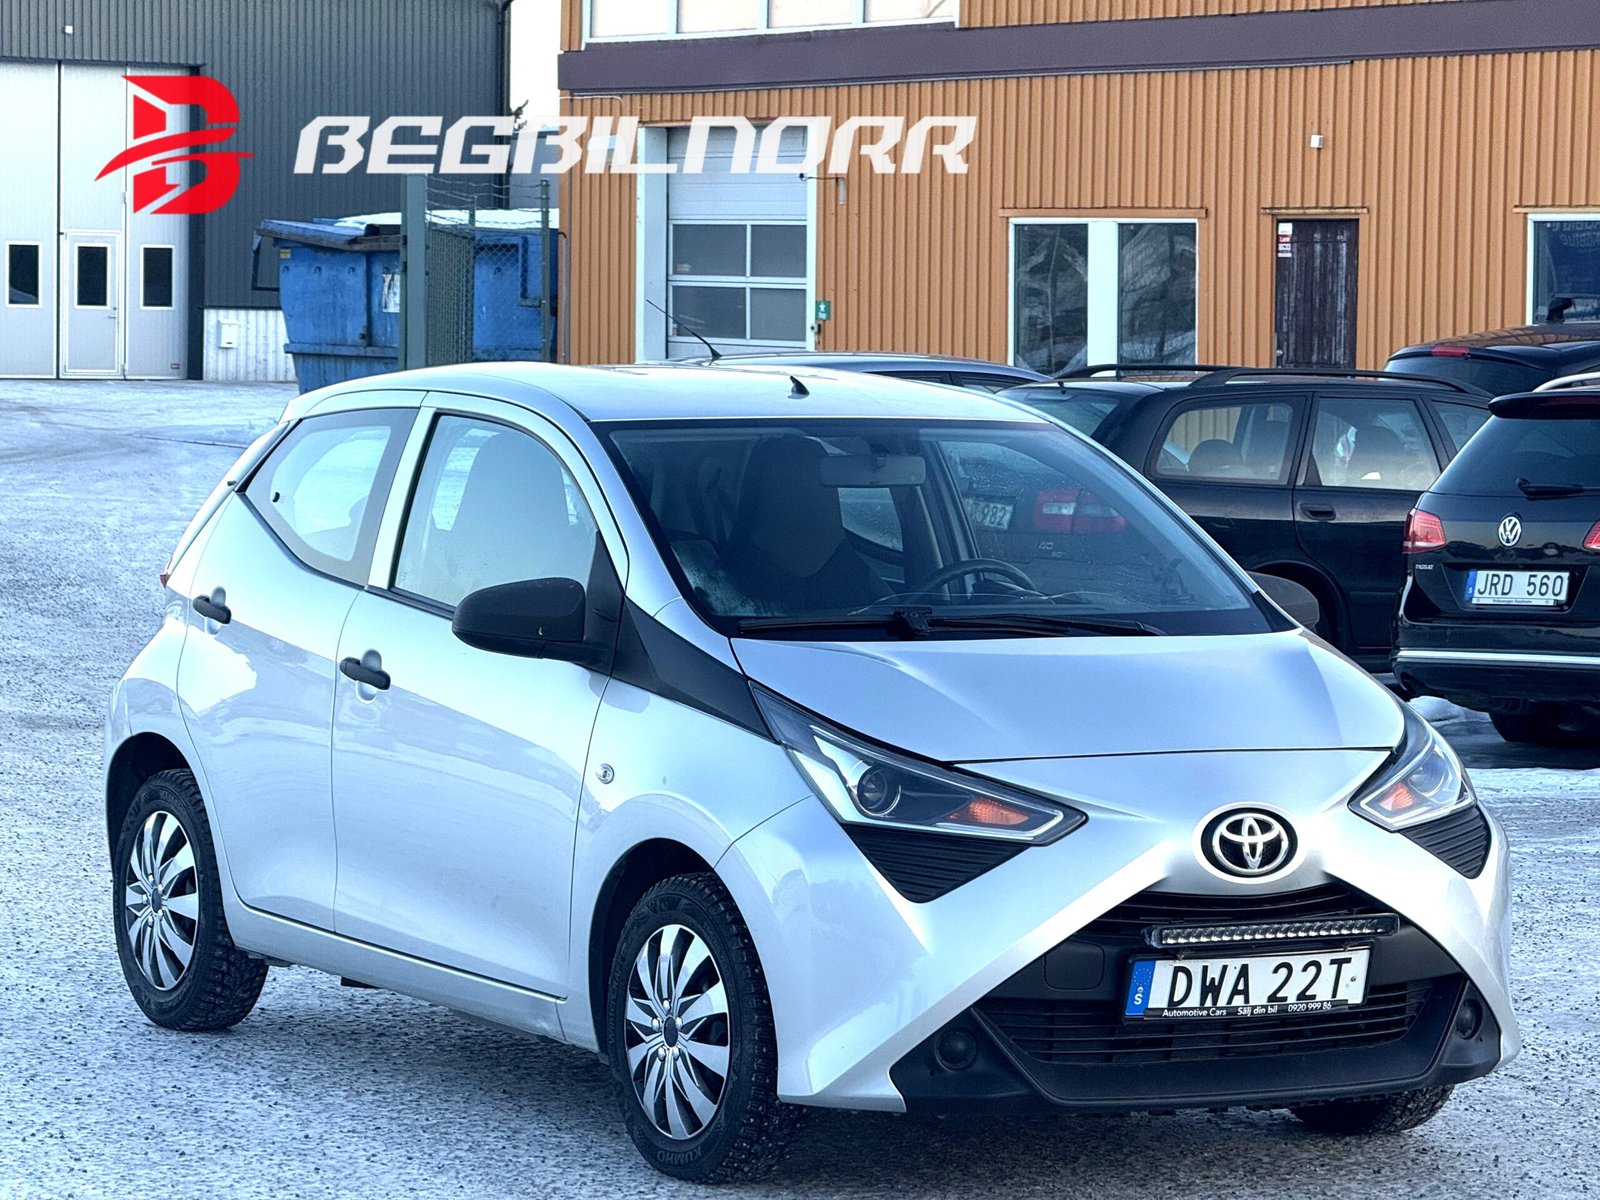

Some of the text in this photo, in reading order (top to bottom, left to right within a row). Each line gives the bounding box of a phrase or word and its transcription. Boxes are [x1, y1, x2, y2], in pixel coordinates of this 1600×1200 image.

[1477, 573, 1564, 597] JRD 560
[1167, 957, 1353, 1008] DWA 22T
[1162, 1007, 1227, 1018] Automotive Cars
[1237, 1005, 1278, 1017] Sälj din bil
[1288, 1001, 1332, 1013] 0920 999 86
[656, 1146, 702, 1166] KUMHO
